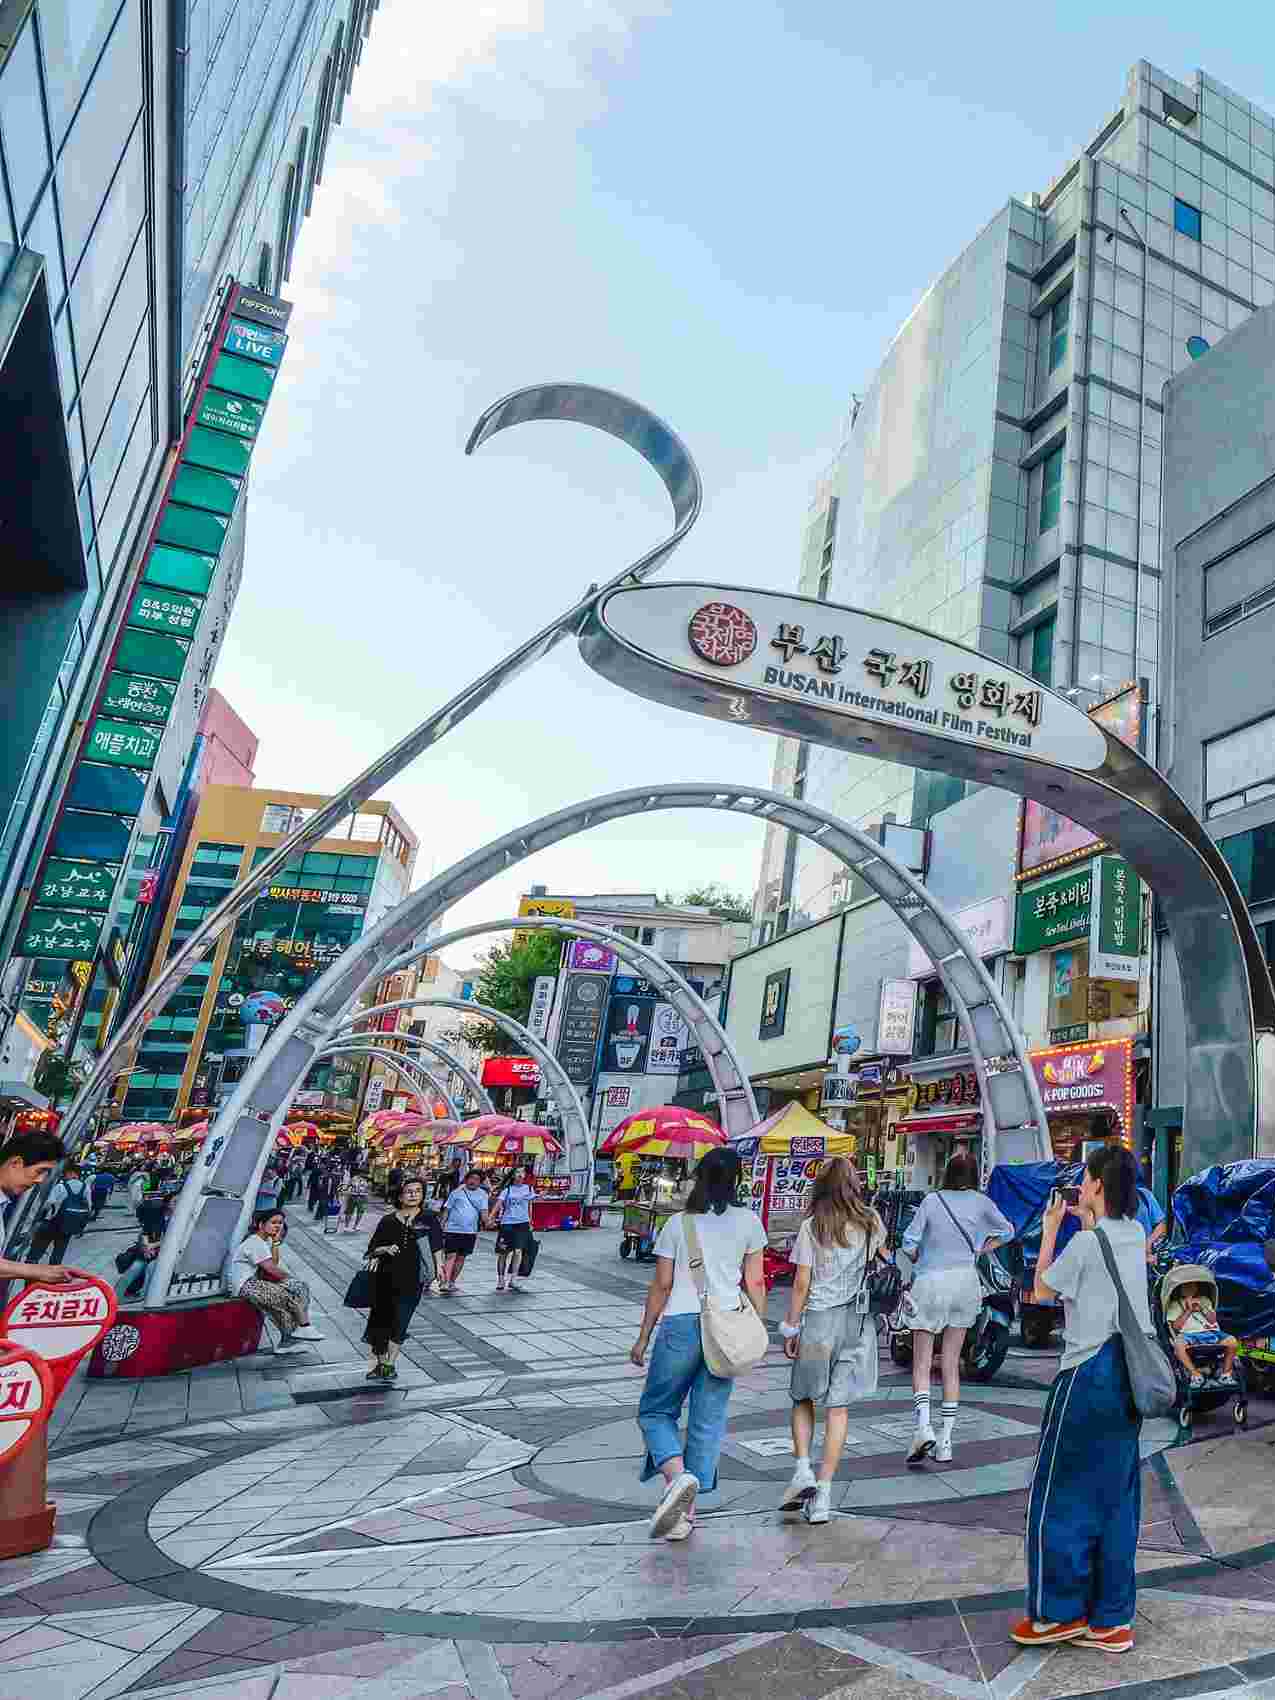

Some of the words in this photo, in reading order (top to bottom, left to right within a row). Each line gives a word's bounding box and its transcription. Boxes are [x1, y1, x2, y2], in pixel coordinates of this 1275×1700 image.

[235, 337, 273, 359] LIVE
[769, 623, 848, 675] 부산
[863, 648, 932, 698] 국제
[950, 673, 1042, 728] 영화제
[764, 666, 834, 699] BUSAN
[838, 686, 937, 725] International
[942, 711, 973, 735] Film
[976, 720, 1032, 748] Festival
[95, 731, 156, 757] 애플치과
[43, 884, 107, 900] 강남교자
[25, 934, 92, 950] 강남교자
[1044, 1086, 1069, 1102] K-POP
[1070, 1083, 1103, 1099] GOODS
[21, 1298, 99, 1322] 주차금지
